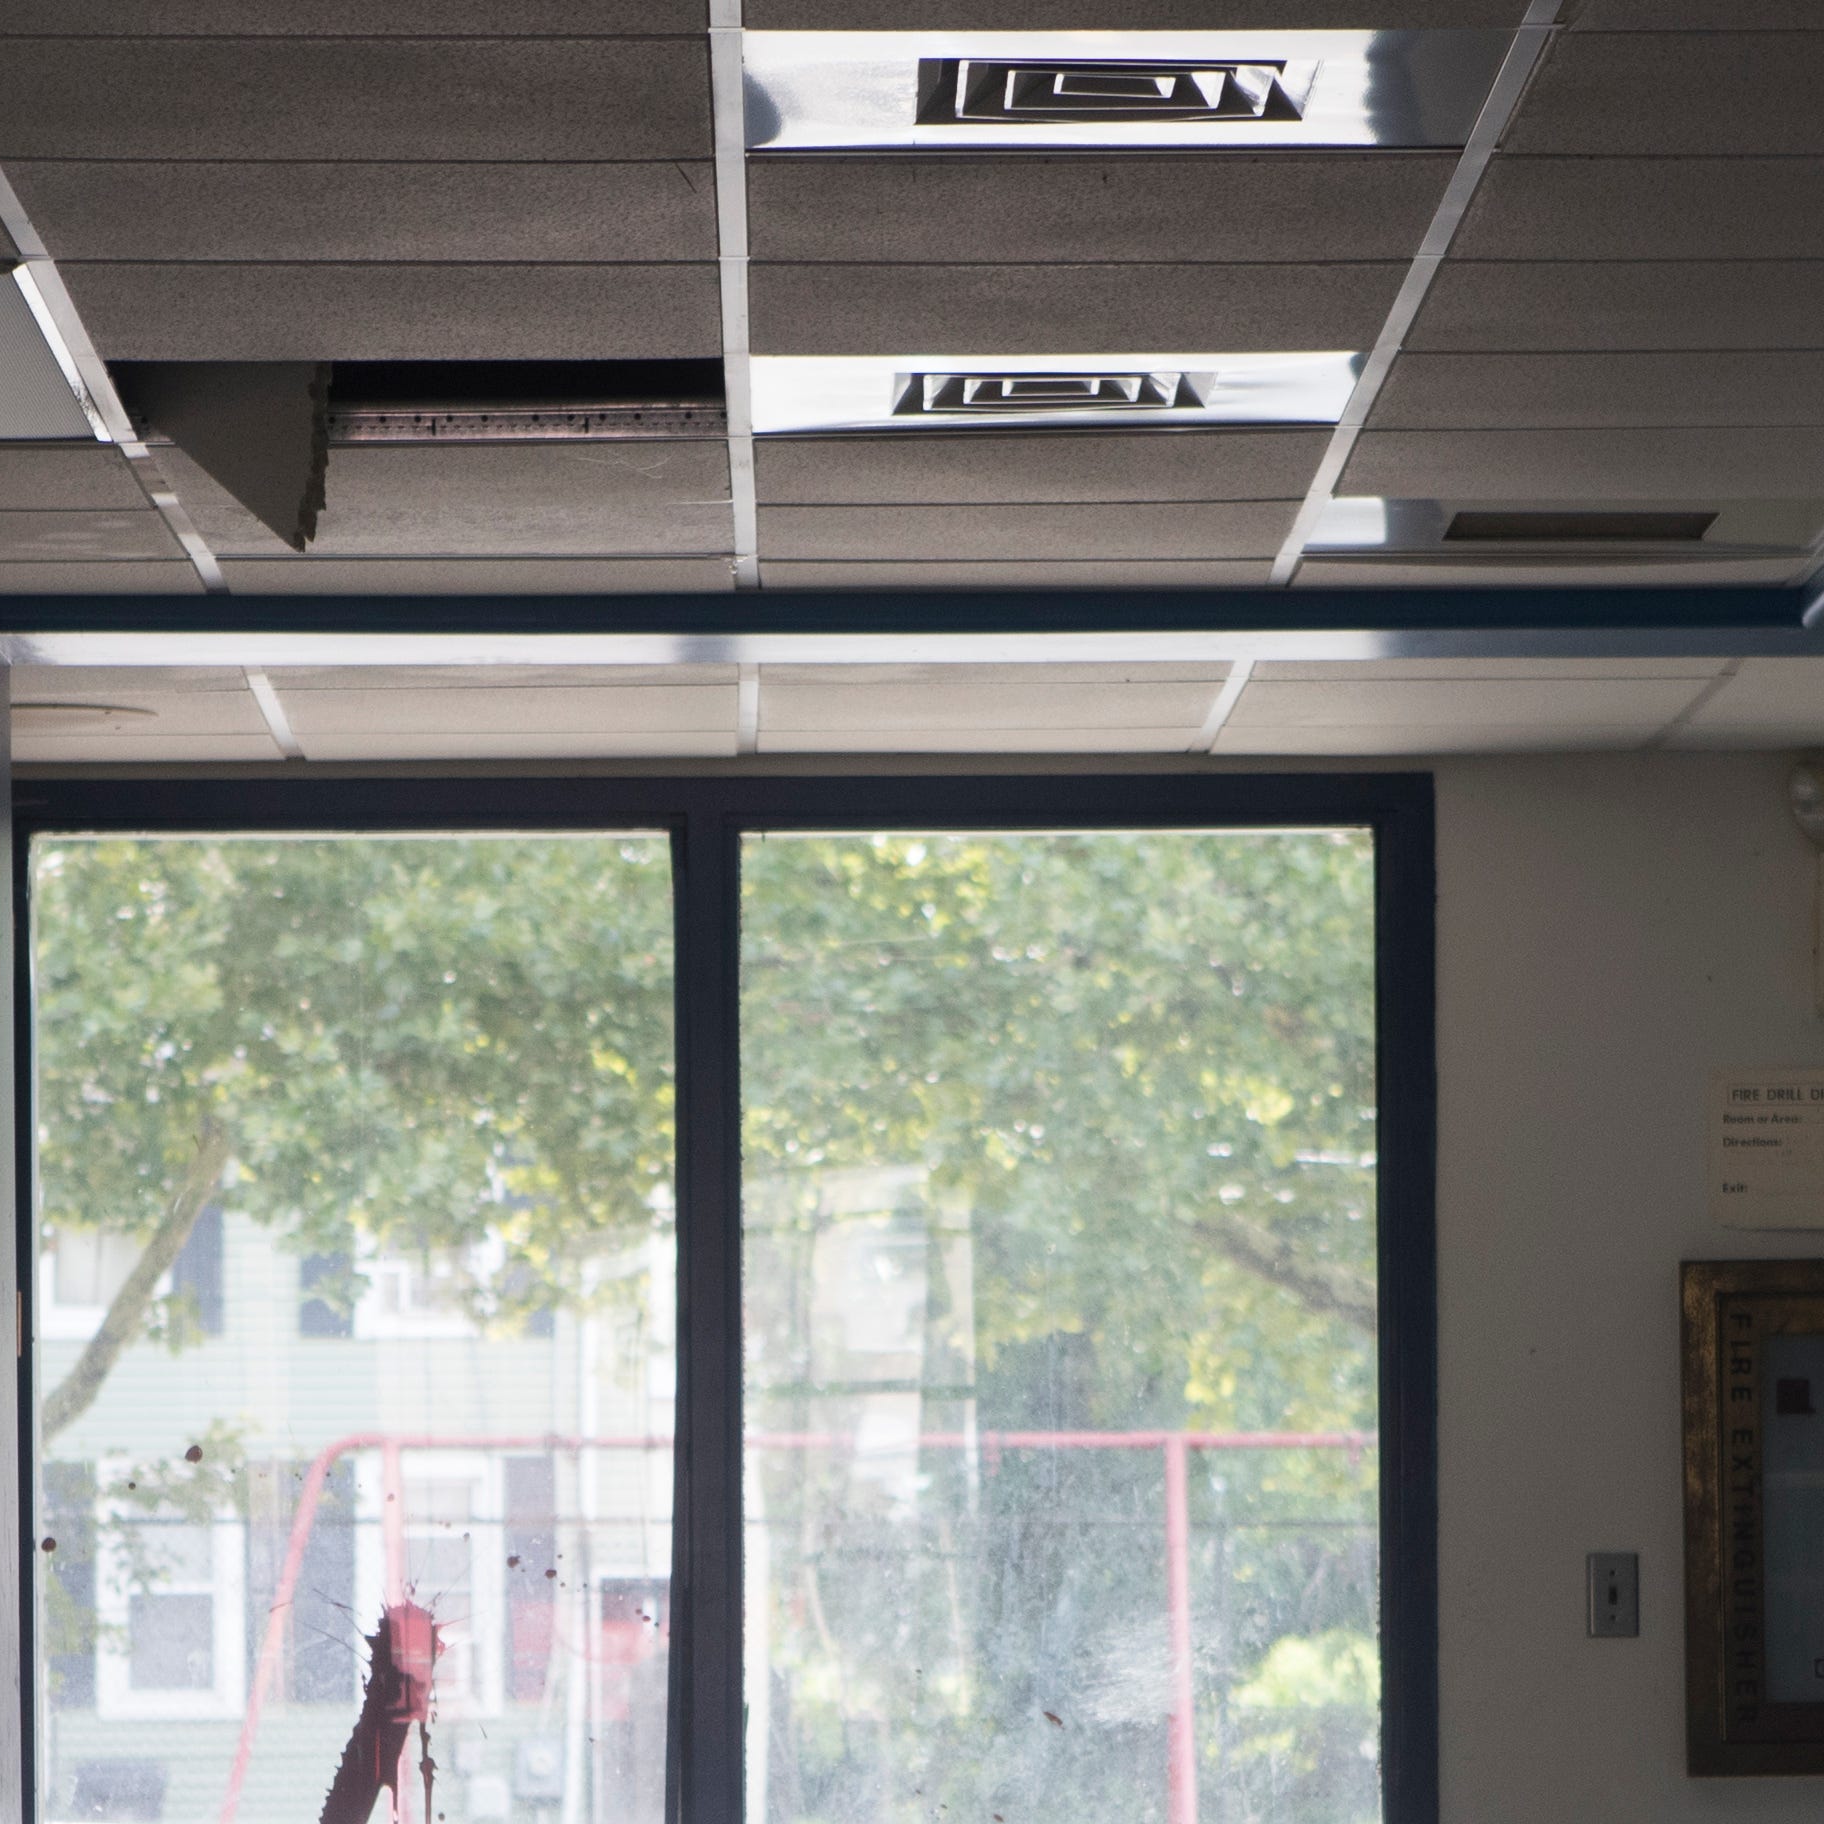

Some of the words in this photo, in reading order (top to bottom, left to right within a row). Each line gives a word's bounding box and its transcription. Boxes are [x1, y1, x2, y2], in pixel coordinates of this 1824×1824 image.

[1732, 1088, 1760, 1101] FIRE
[1767, 1088, 1803, 1101] DRILL
[1723, 1113, 1755, 1124] Room
[1757, 1115, 1770, 1124] or
[1722, 1137, 1782, 1147] Directions:
[1722, 1183, 1748, 1193] Exit:
[1730, 1312, 1753, 1403] FIRE
[1732, 1427, 1759, 1724] EXTINGUISHER
